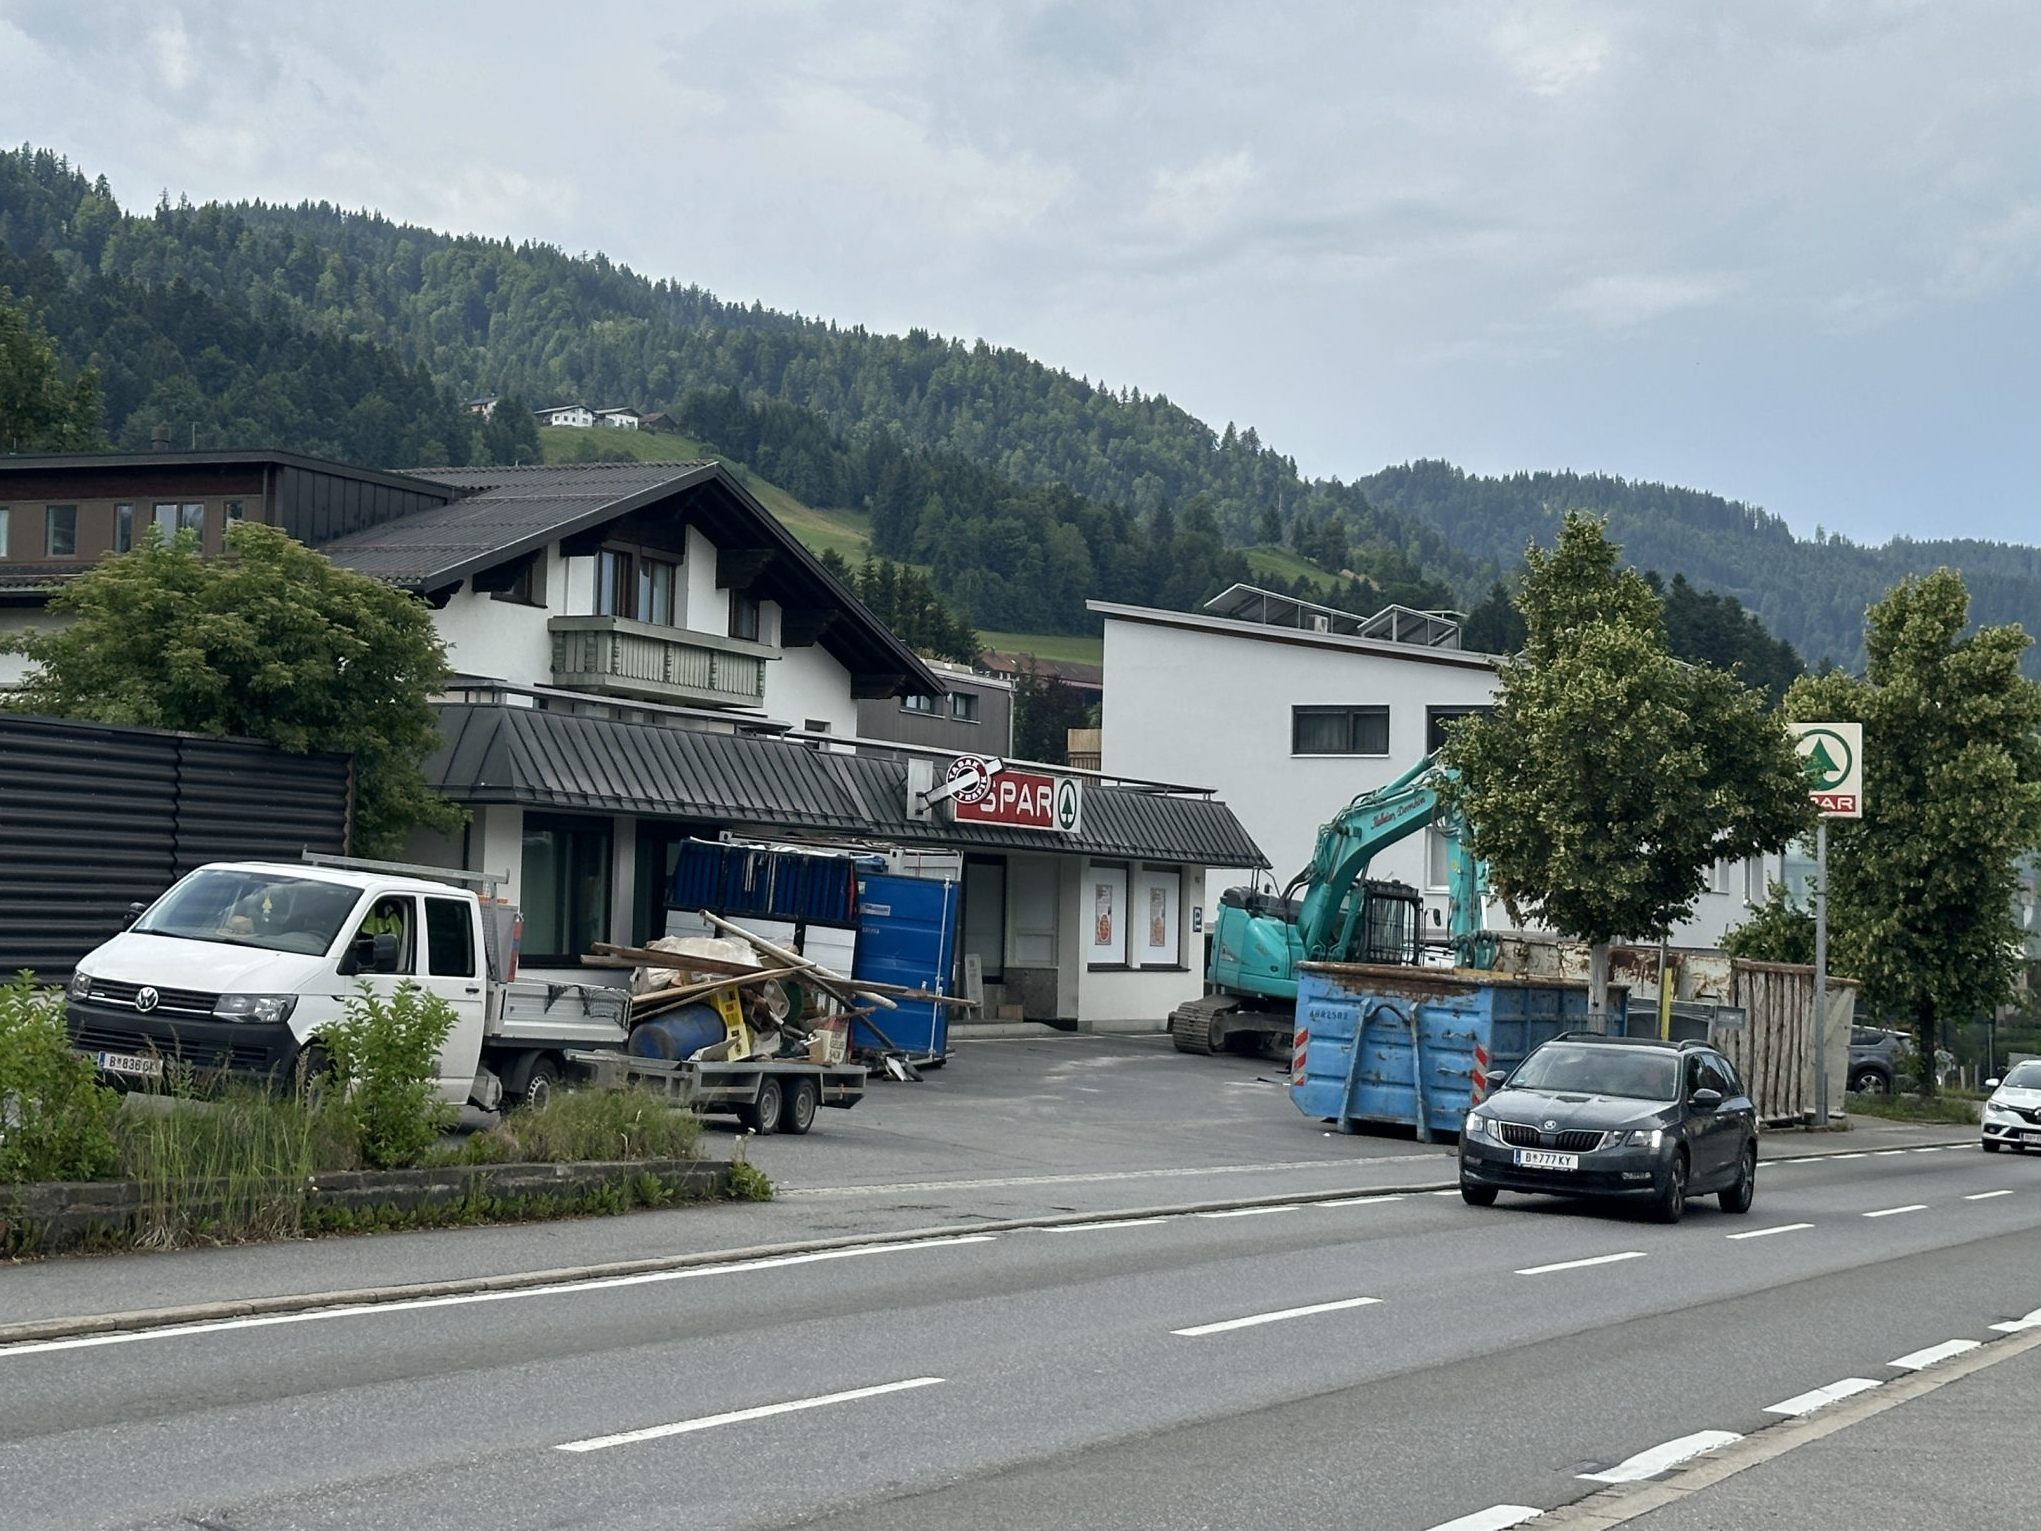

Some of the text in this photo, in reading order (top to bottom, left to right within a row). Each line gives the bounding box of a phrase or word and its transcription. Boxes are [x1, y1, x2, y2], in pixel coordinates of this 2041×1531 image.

[949, 759, 979, 780] TABAK
[958, 775, 988, 801] TRAFIK
[980, 781, 1052, 818] SPAR
